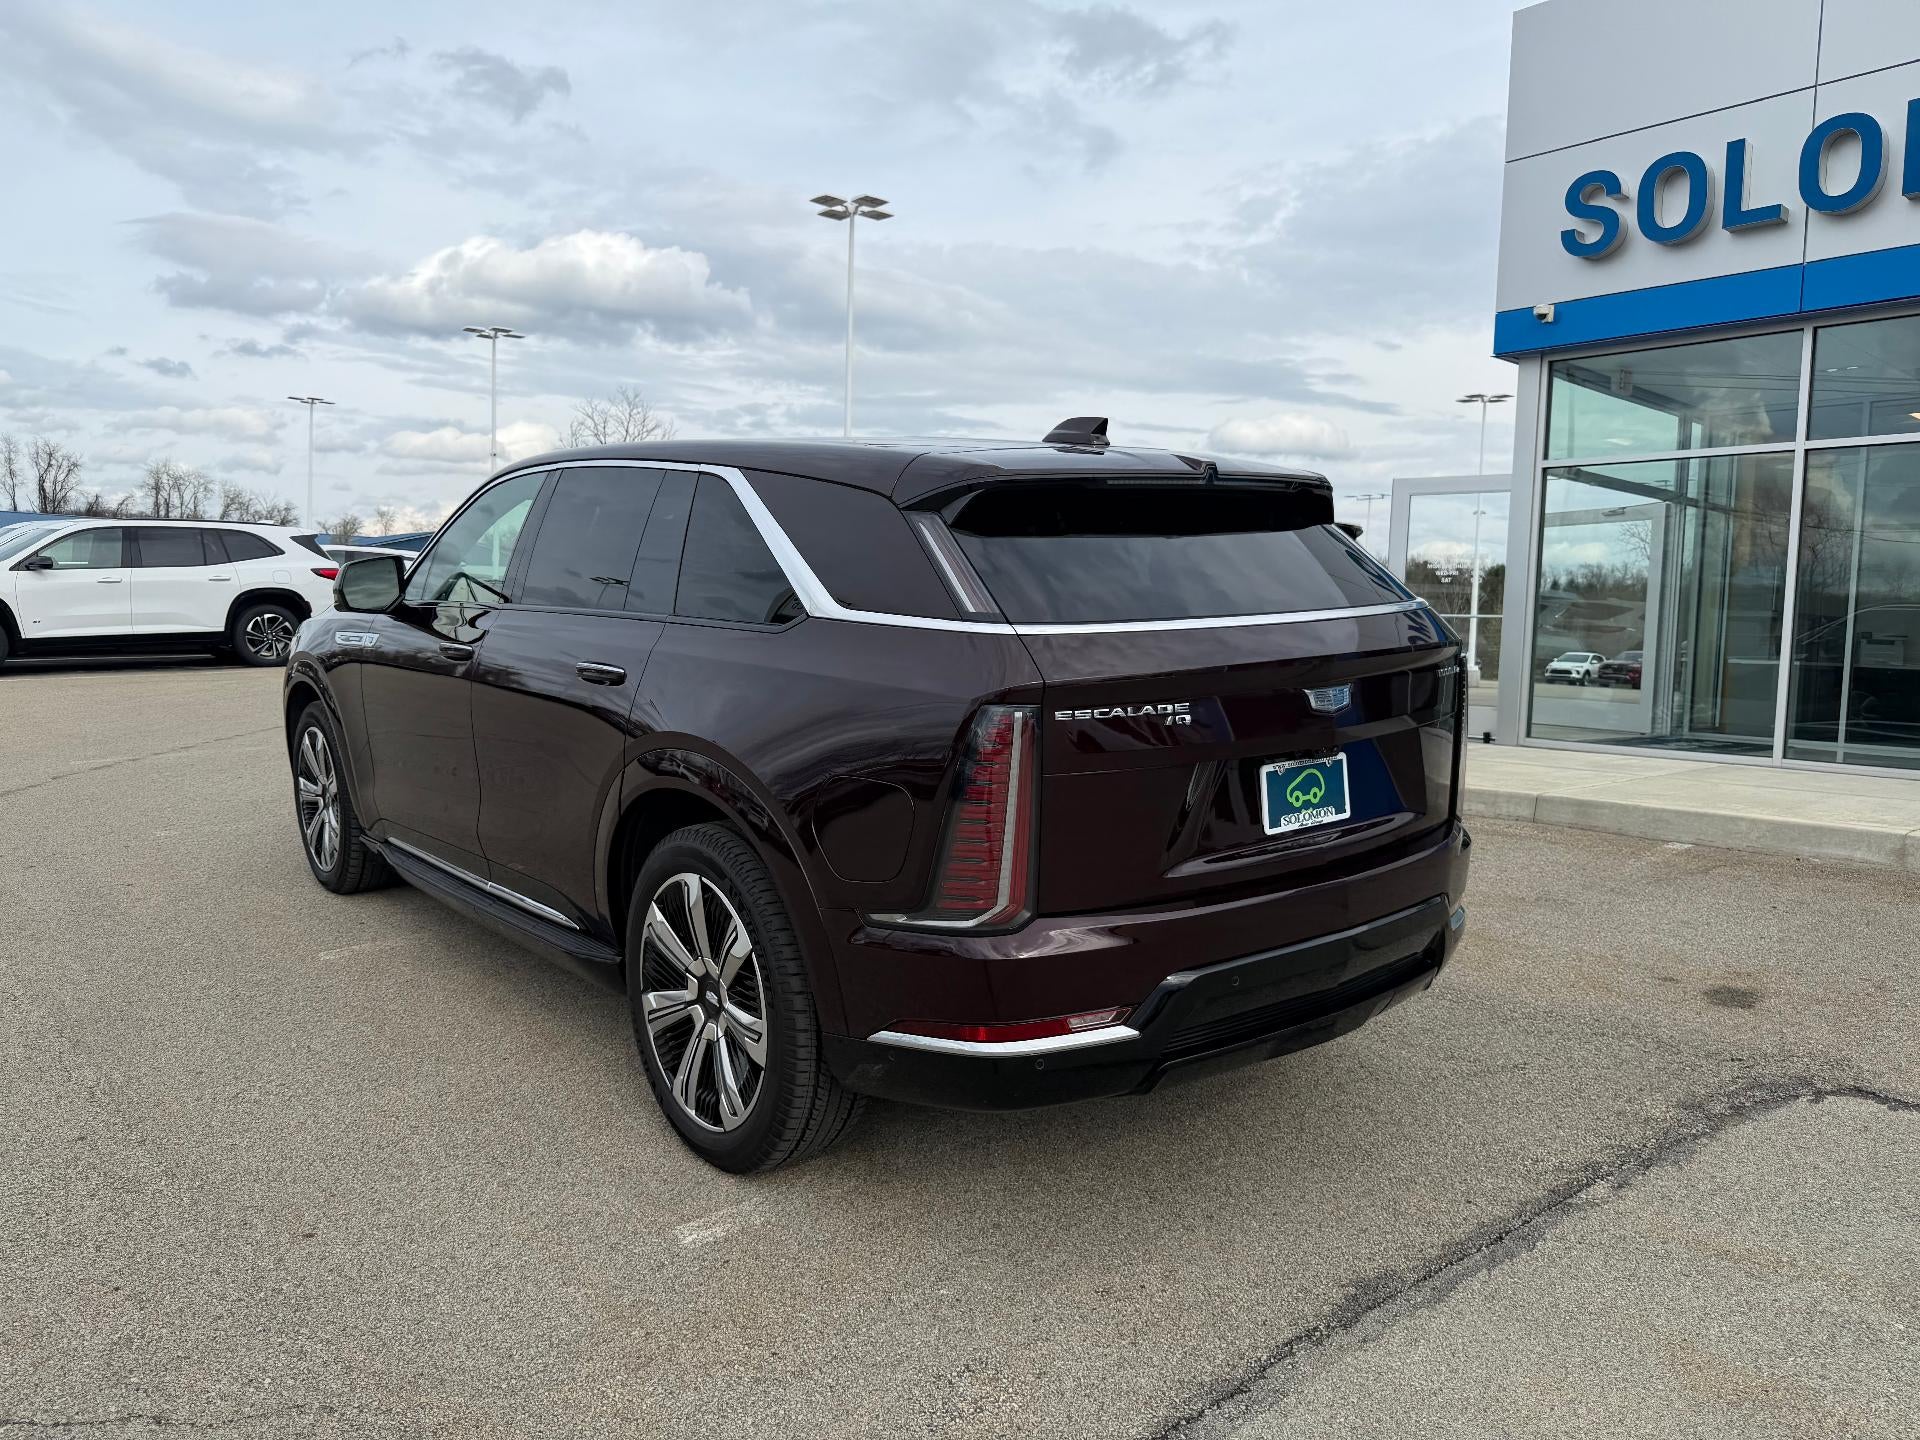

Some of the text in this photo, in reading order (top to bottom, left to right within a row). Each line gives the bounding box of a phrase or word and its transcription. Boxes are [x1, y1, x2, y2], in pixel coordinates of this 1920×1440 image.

[1561, 98, 1920, 259] SOLO
[1054, 702, 1190, 721] ESCALADE
[1282, 805, 1334, 827] SOLOMON
